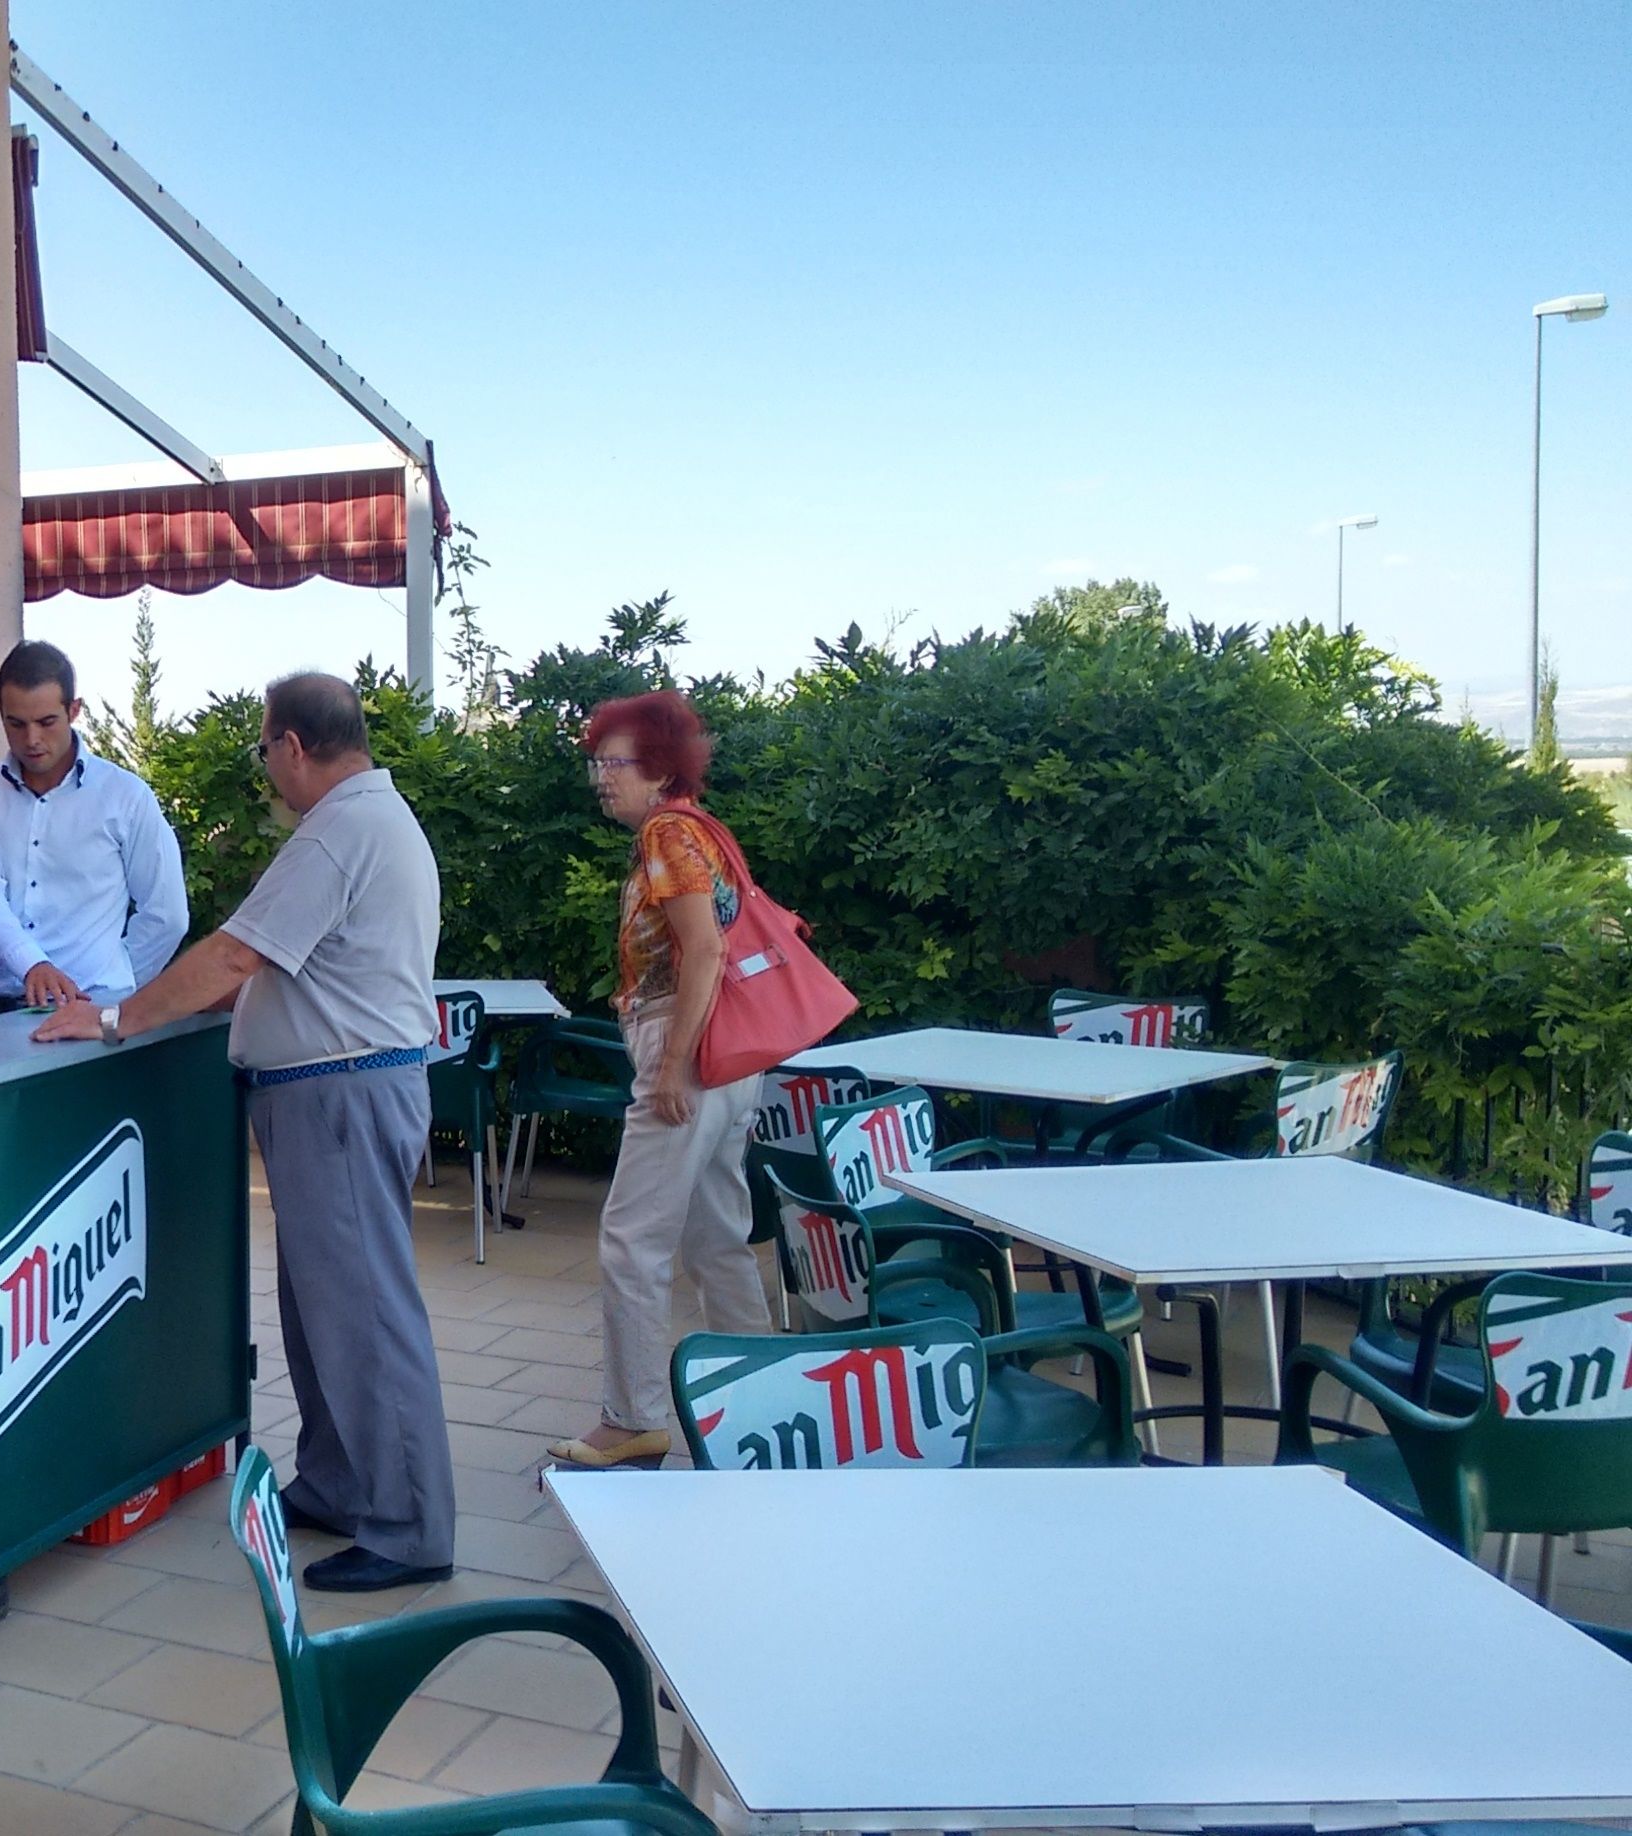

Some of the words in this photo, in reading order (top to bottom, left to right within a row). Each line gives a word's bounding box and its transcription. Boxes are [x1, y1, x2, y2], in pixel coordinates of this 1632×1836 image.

[748, 1102, 792, 1143] an
[1277, 1103, 1336, 1155] an
[828, 1151, 875, 1206] an
[1487, 1337, 1616, 1417] an
[695, 1407, 822, 1469] an
